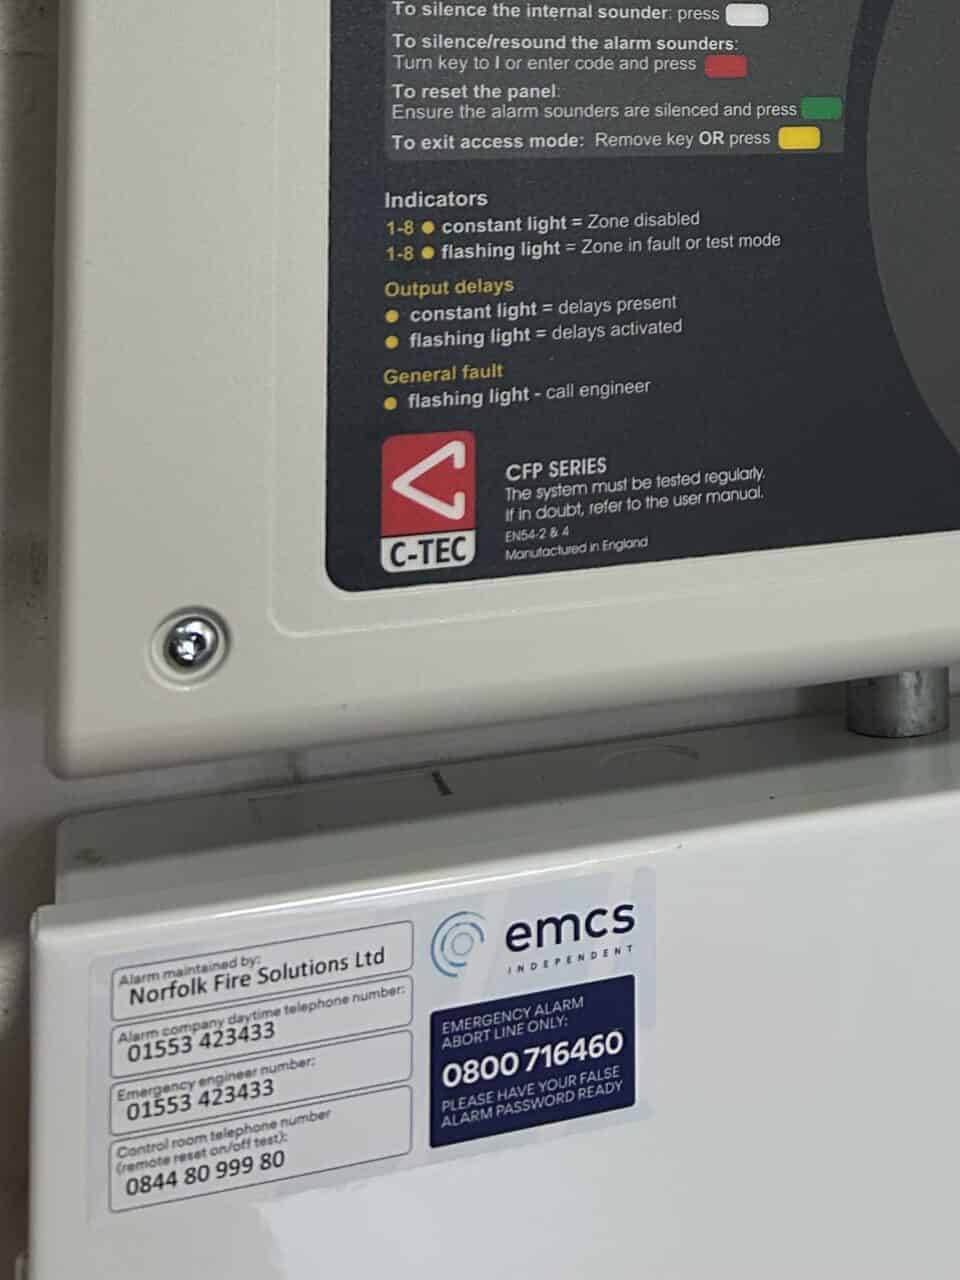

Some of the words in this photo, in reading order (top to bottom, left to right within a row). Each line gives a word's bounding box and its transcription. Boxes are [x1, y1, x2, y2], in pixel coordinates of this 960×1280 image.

[393, 1, 416, 17] To
[421, 2, 487, 18] silence
[493, 3, 521, 19] the
[526, 4, 593, 20] internal
[598, 5, 672, 21] sounder:
[678, 6, 719, 22] press
[393, 34, 416, 50] To
[421, 33, 565, 51] silence/resound
[571, 35, 598, 50] the
[604, 35, 651, 51] alarm
[657, 36, 738, 52] sounders:
[393, 84, 416, 99] To
[421, 84, 468, 99] reset
[474, 84, 502, 99] the
[508, 84, 559, 102] panel:
[384, 191, 488, 209] Indicators
[386, 220, 414, 236] 1-8
[442, 218, 521, 234] constant
[527, 215, 567, 233] light
[588, 214, 630, 230] Zone
[634, 211, 701, 227] disabled
[384, 280, 451, 299] Output
[455, 278, 514, 295] delays
[383, 365, 457, 384] General
[462, 363, 505, 380] fault
[506, 462, 543, 481] CFP
[549, 457, 607, 478] SERIES
[506, 487, 531, 503] The
[536, 482, 587, 503] system
[592, 479, 627, 496] must
[632, 477, 651, 491] be
[656, 472, 701, 489] tested
[704, 466, 766, 486] regularly.
[390, 536, 466, 567] C-TEC
[506, 904, 635, 952] emcs
[129, 974, 207, 1007] Norfolk
[213, 969, 252, 991] Fire
[257, 952, 349, 984] Solutions
[355, 946, 385, 969] Ltd
[127, 1033, 193, 1064] 01553
[199, 1020, 276, 1049] 423433
[442, 1052, 519, 1087] 0800
[523, 1031, 624, 1072] 716460
